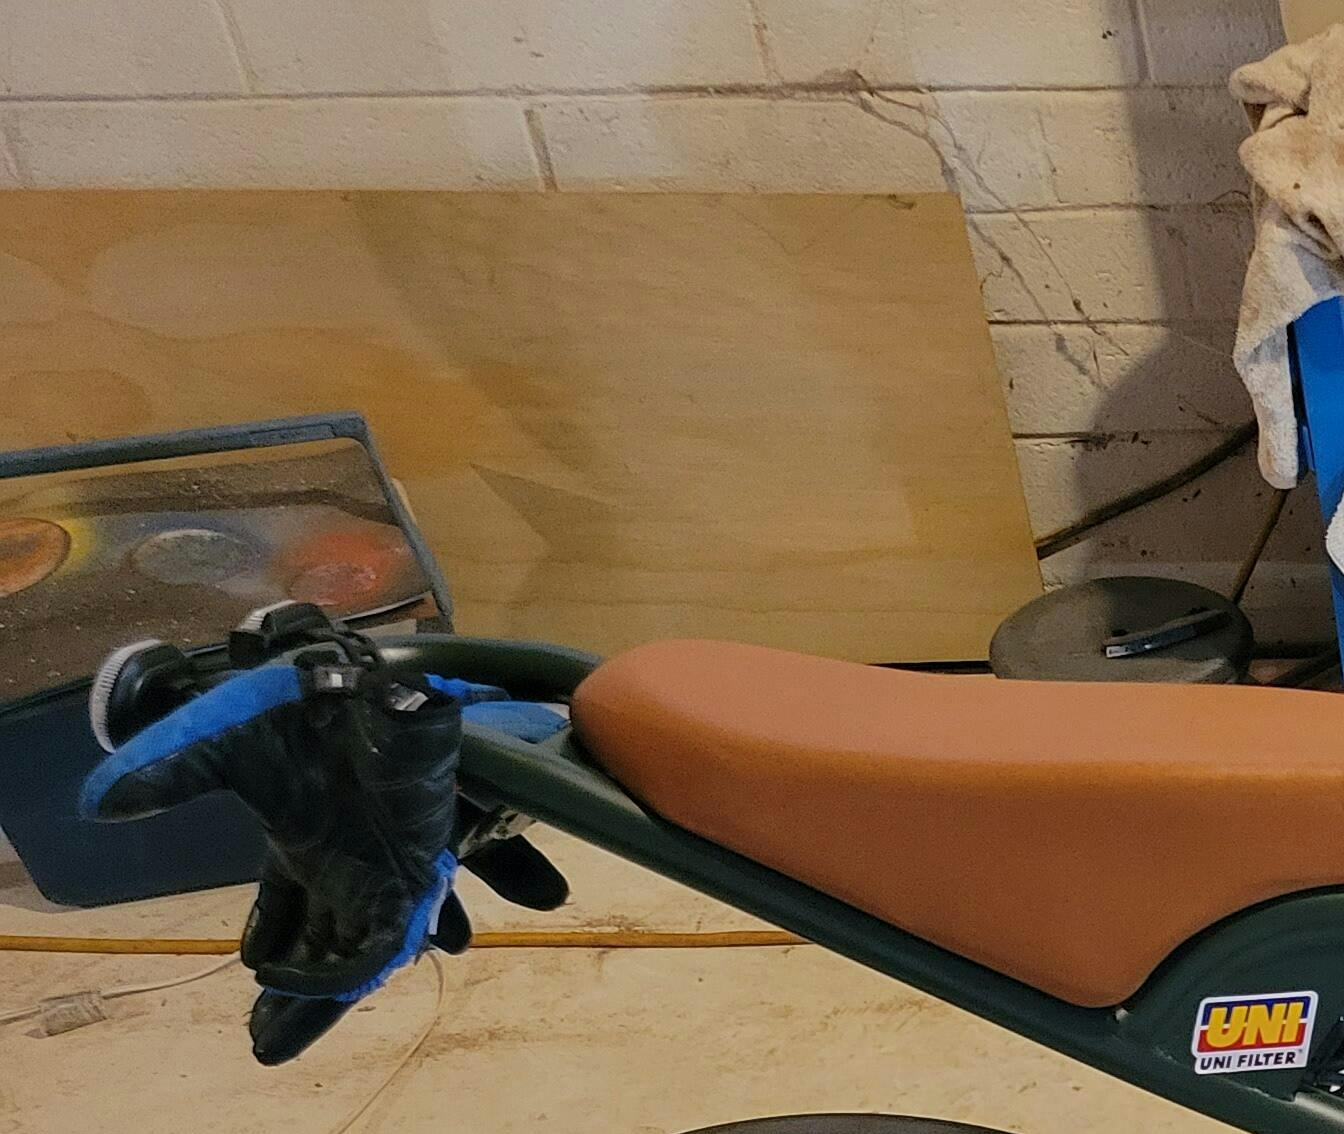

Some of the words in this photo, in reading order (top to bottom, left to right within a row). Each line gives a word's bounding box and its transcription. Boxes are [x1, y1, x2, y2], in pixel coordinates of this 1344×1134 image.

[1206, 1001, 1305, 1049] UNI
[1199, 1055, 1233, 1071] UNI
[1236, 1051, 1297, 1069] FILTER
